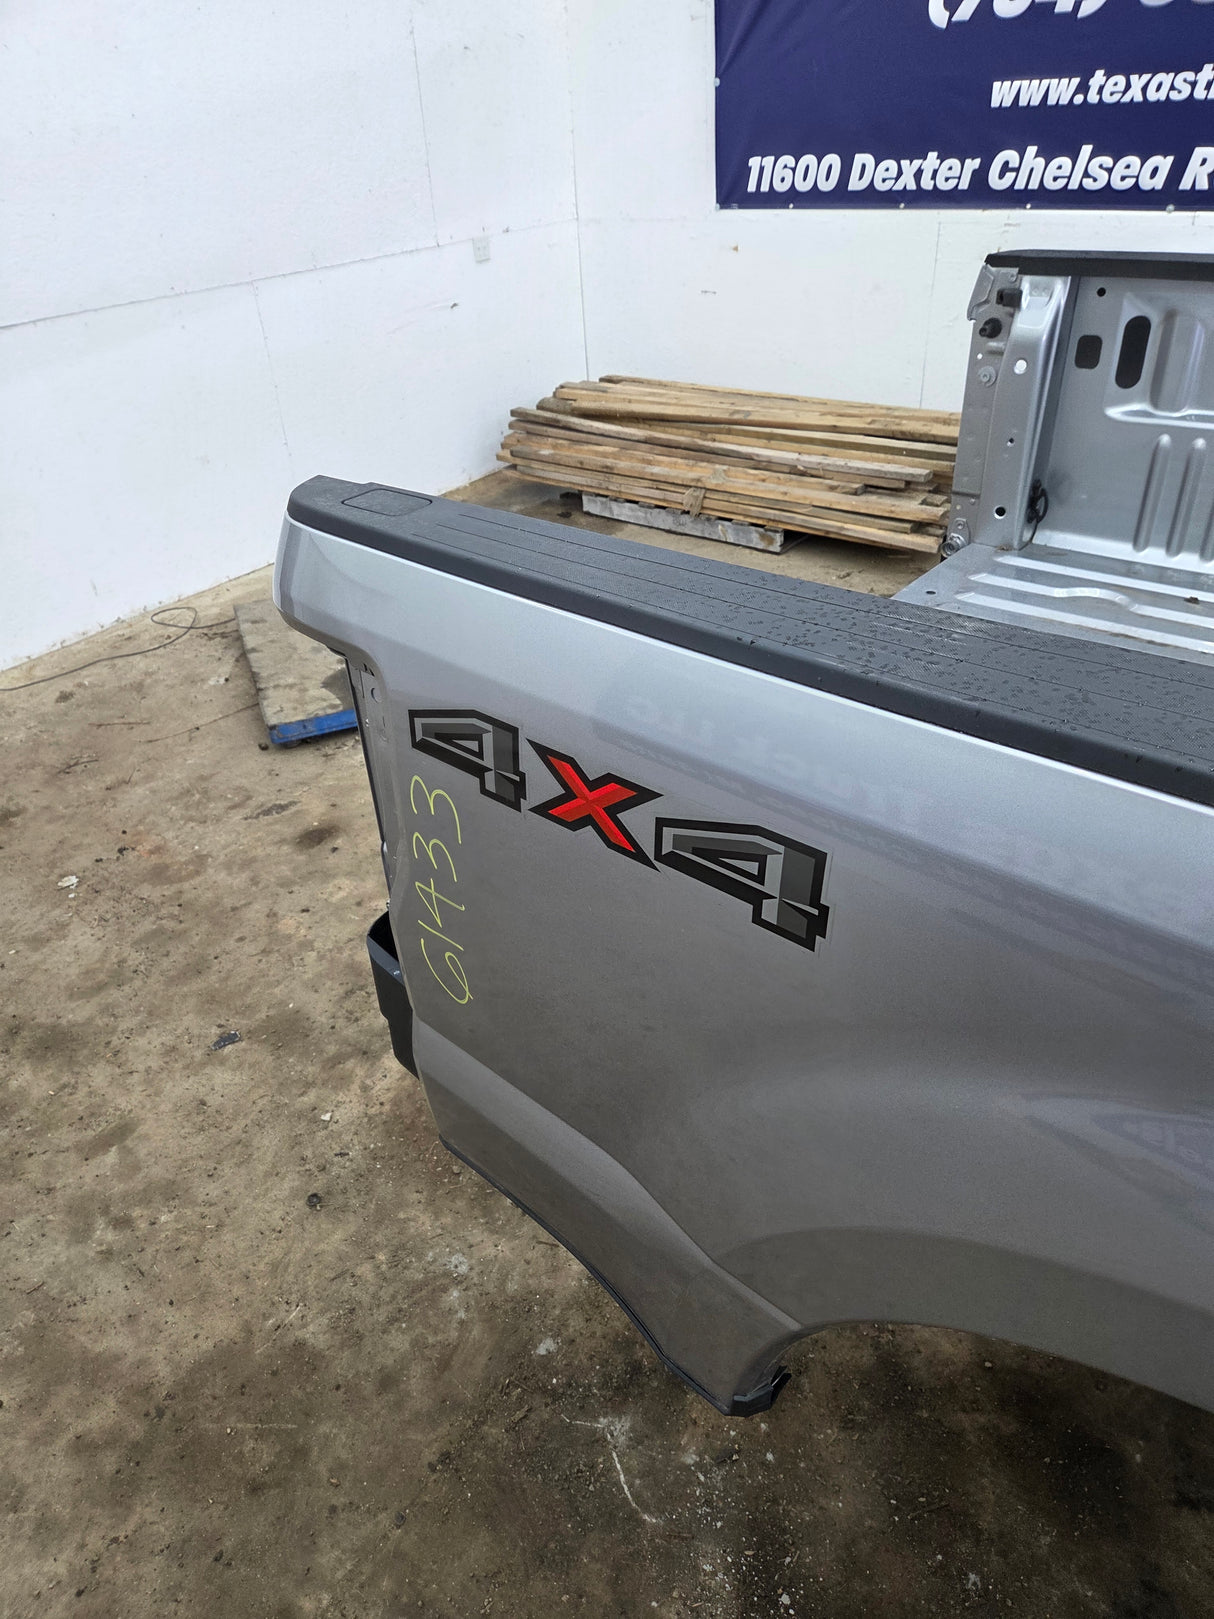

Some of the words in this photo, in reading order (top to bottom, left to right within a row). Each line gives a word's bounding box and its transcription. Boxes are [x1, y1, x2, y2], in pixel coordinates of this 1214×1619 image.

[747, 153, 842, 193] 11600
[847, 151, 982, 192] Dexter
[987, 144, 1175, 191] Chelsea
